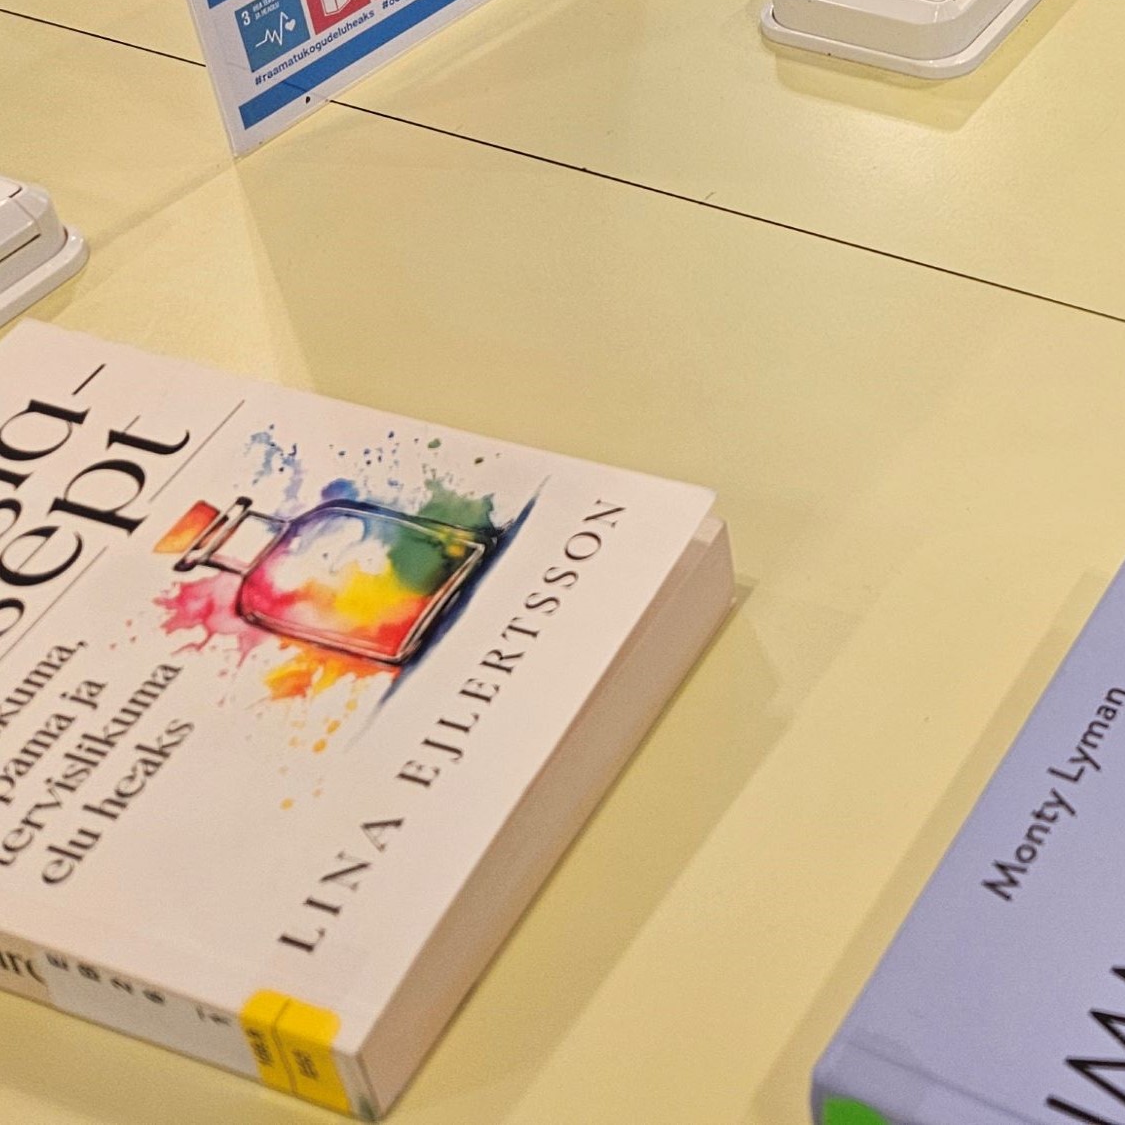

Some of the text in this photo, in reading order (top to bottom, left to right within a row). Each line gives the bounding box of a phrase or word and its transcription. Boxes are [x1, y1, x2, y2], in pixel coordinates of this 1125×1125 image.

[242, 10, 252, 26] 3
[255, 10, 375, 85] #raamatukogudeluheaks
[60, 678, 108, 711] ja
[277, 496, 629, 956] LINA EJLERTSSON
[41, 718, 196, 885] elu heaks
[980, 786, 1078, 902] Monty
